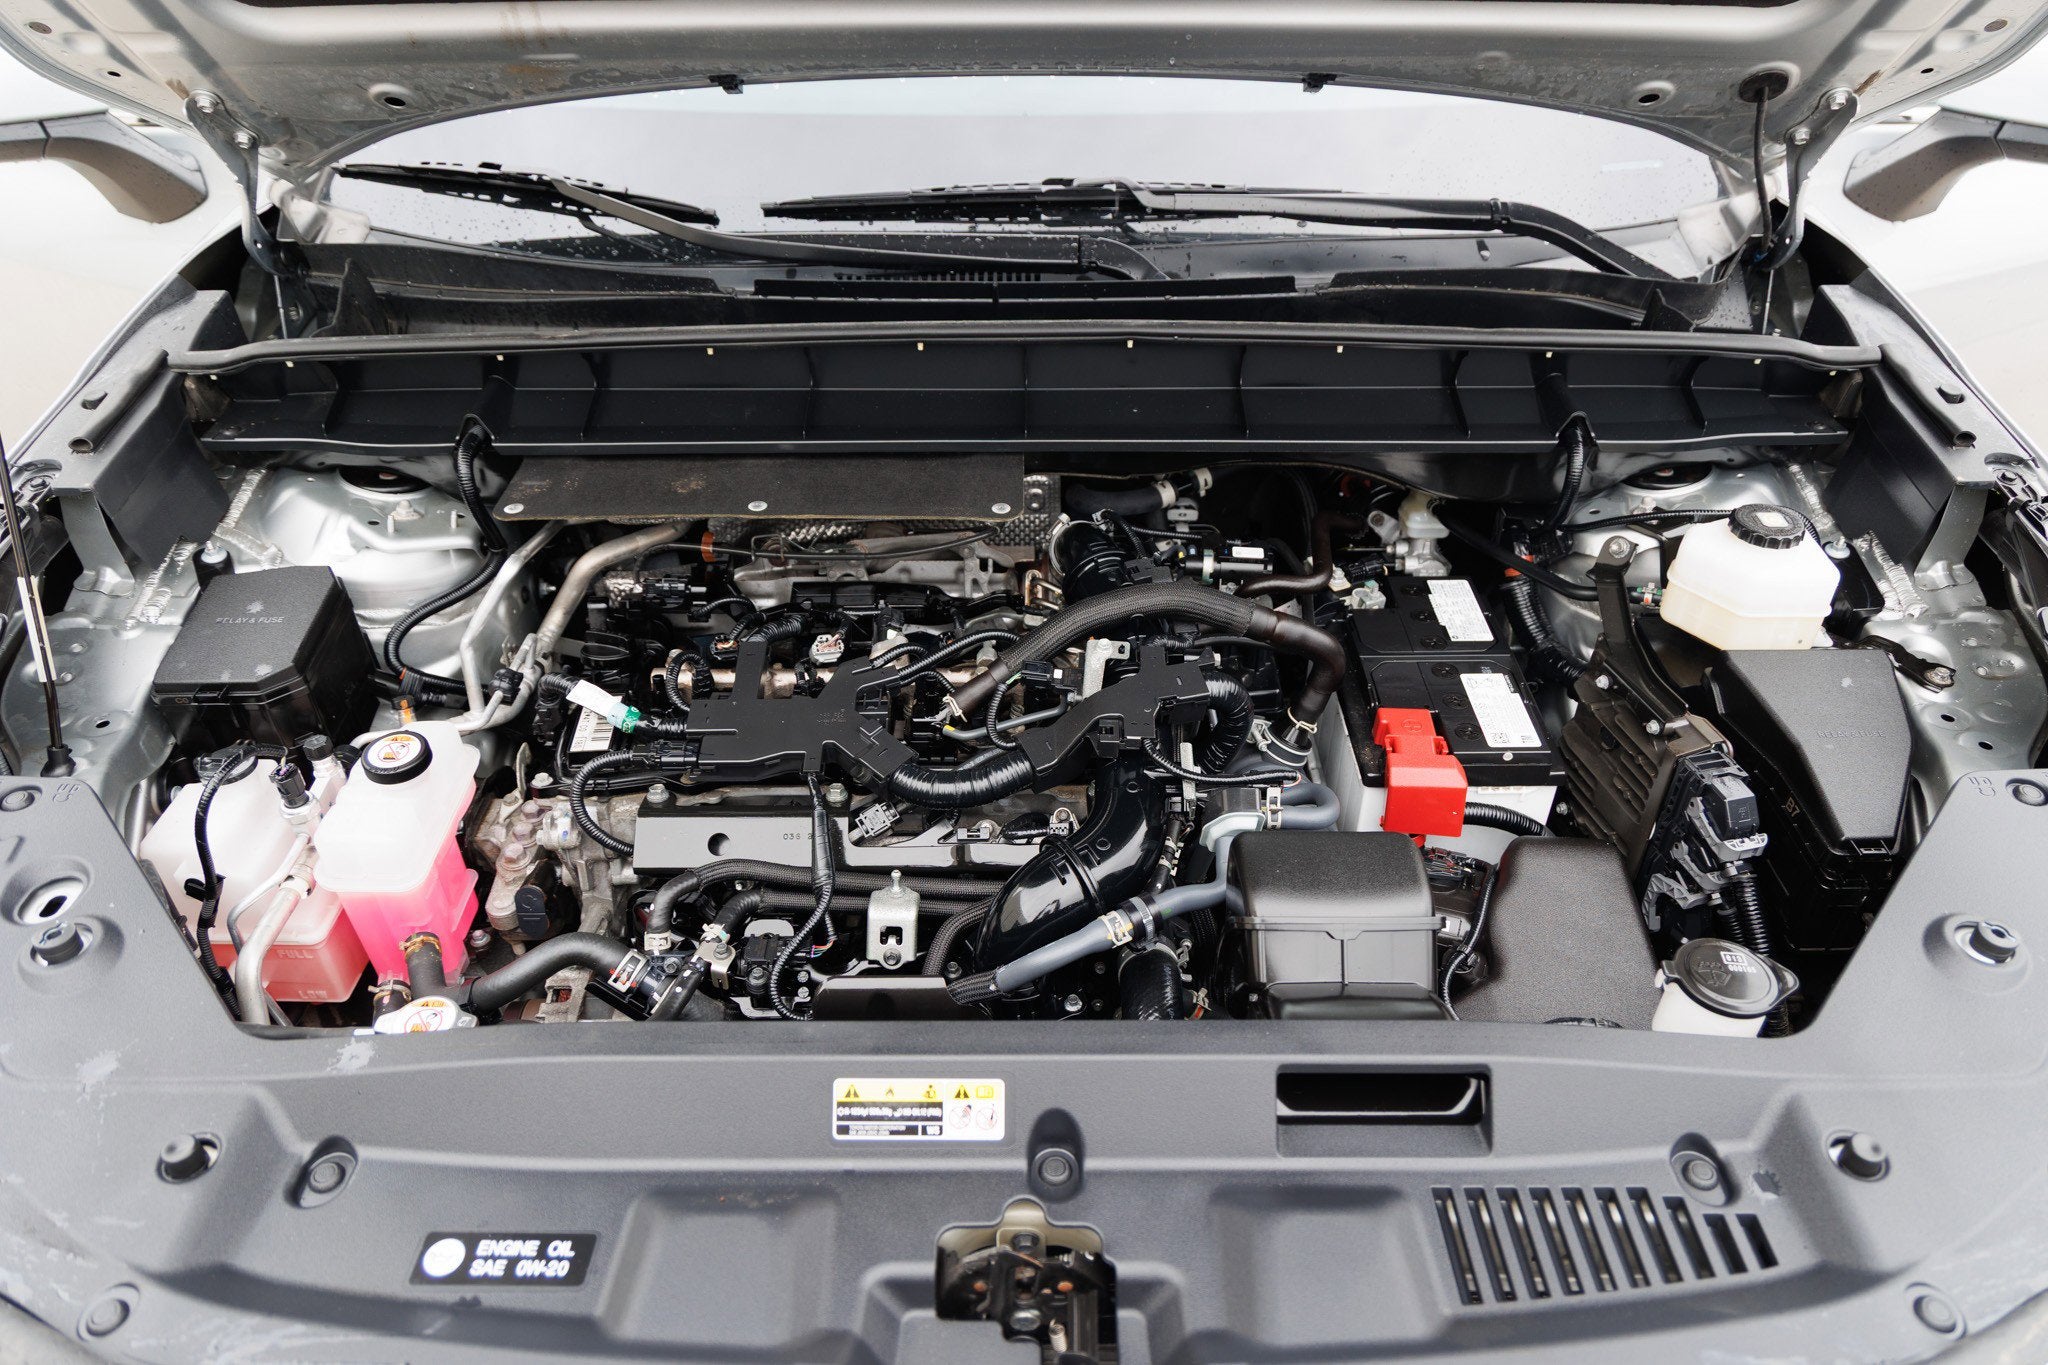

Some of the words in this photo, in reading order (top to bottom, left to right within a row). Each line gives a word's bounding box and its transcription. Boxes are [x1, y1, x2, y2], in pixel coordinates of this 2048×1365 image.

[257, 616, 285, 624] FUSE
[276, 949, 314, 959] FULL
[298, 990, 328, 999] LOW
[475, 1239, 541, 1257] ENGINE
[547, 1240, 576, 1258] OIL
[468, 1259, 508, 1277] SAE
[515, 1259, 571, 1278] 0W-20
